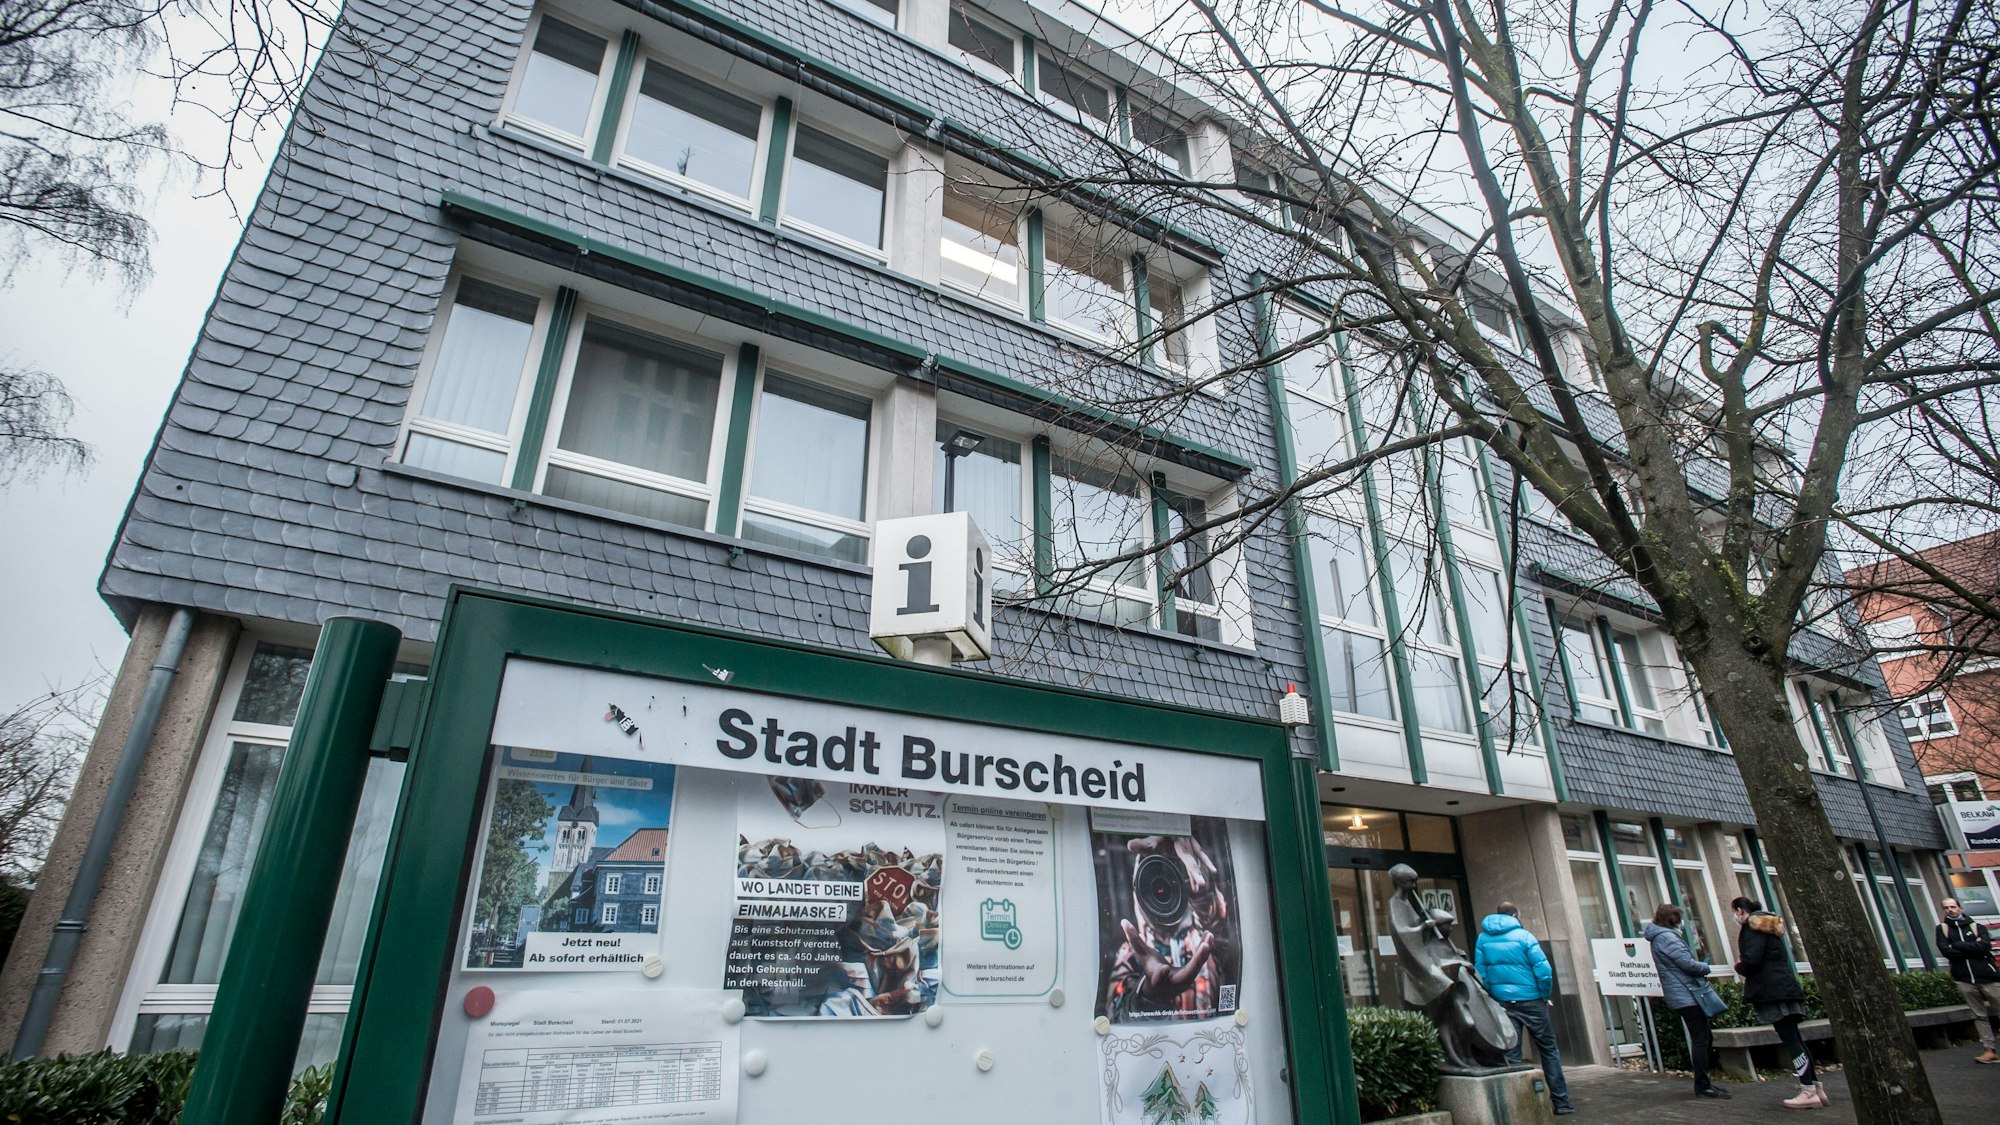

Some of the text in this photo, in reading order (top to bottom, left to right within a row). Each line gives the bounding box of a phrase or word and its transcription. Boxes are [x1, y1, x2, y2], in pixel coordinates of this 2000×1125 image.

[716, 708, 1147, 802] Stadt Burscheid
[507, 768, 648, 788] Wissenswertes für Bürger und Gäste
[849, 798, 940, 818] SCHMUTZ.
[952, 803, 1046, 819] Termin online vereinbaren
[957, 832, 993, 841] Bürgerservice
[1006, 858, 1035, 866] Bürgerbüro
[742, 881, 860, 897] WO LANDET DEINE
[873, 872, 908, 904] STO
[739, 904, 844, 919] EINMALMASKE?
[986, 912, 1010, 920] Termin
[734, 925, 835, 936] Bis eine Schutzmaske
[562, 938, 621, 947] Jetzt neu!
[751, 939, 801, 947] Kunststoff
[803, 940, 841, 950] verottet,
[529, 953, 644, 963] Ab sofort erhältlich
[729, 951, 762, 960] dauert
[794, 953, 812, 961] 450
[814, 953, 842, 962] Jahre.
[728, 965, 753, 974] Nach
[756, 965, 801, 974] Gebrauch
[727, 978, 806, 987] in den Restmüll.
[1792, 1052, 1808, 1070] NIKE
